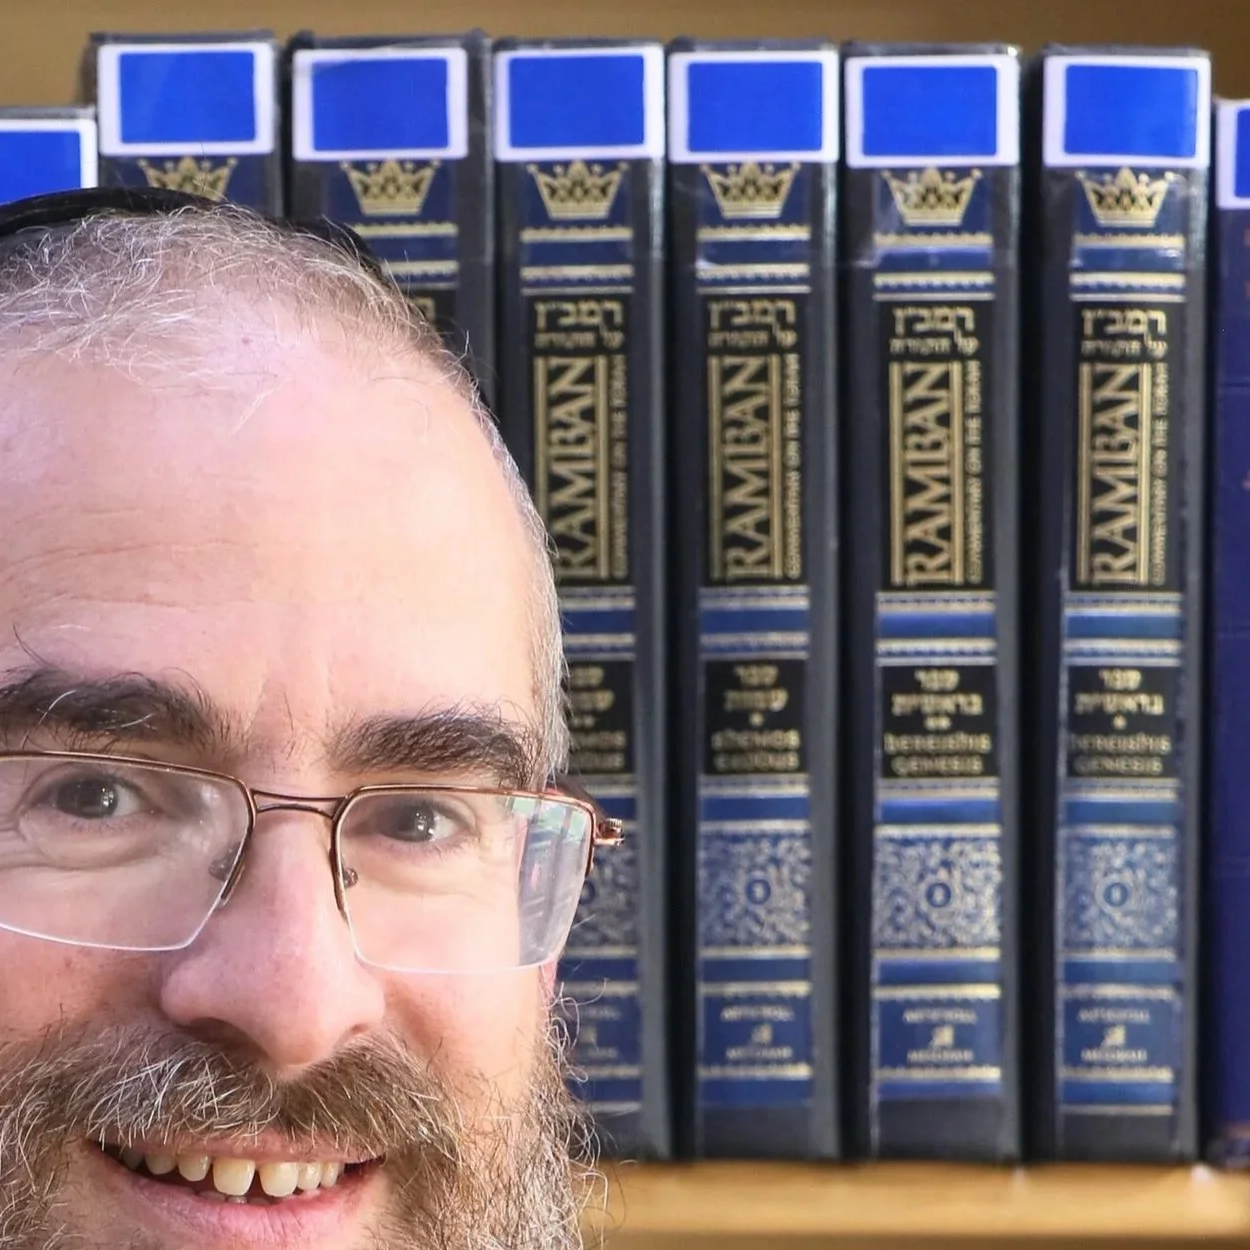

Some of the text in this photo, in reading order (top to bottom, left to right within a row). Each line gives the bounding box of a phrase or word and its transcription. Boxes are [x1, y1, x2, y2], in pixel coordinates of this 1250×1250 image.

[546, 355, 597, 579] RAMBAN
[721, 354, 769, 580] RAMBAN
[902, 361, 950, 586] RAMBAN
[966, 417, 982, 446] THE
[1091, 362, 1139, 584] RAMBAN
[1151, 418, 1168, 447] THE
